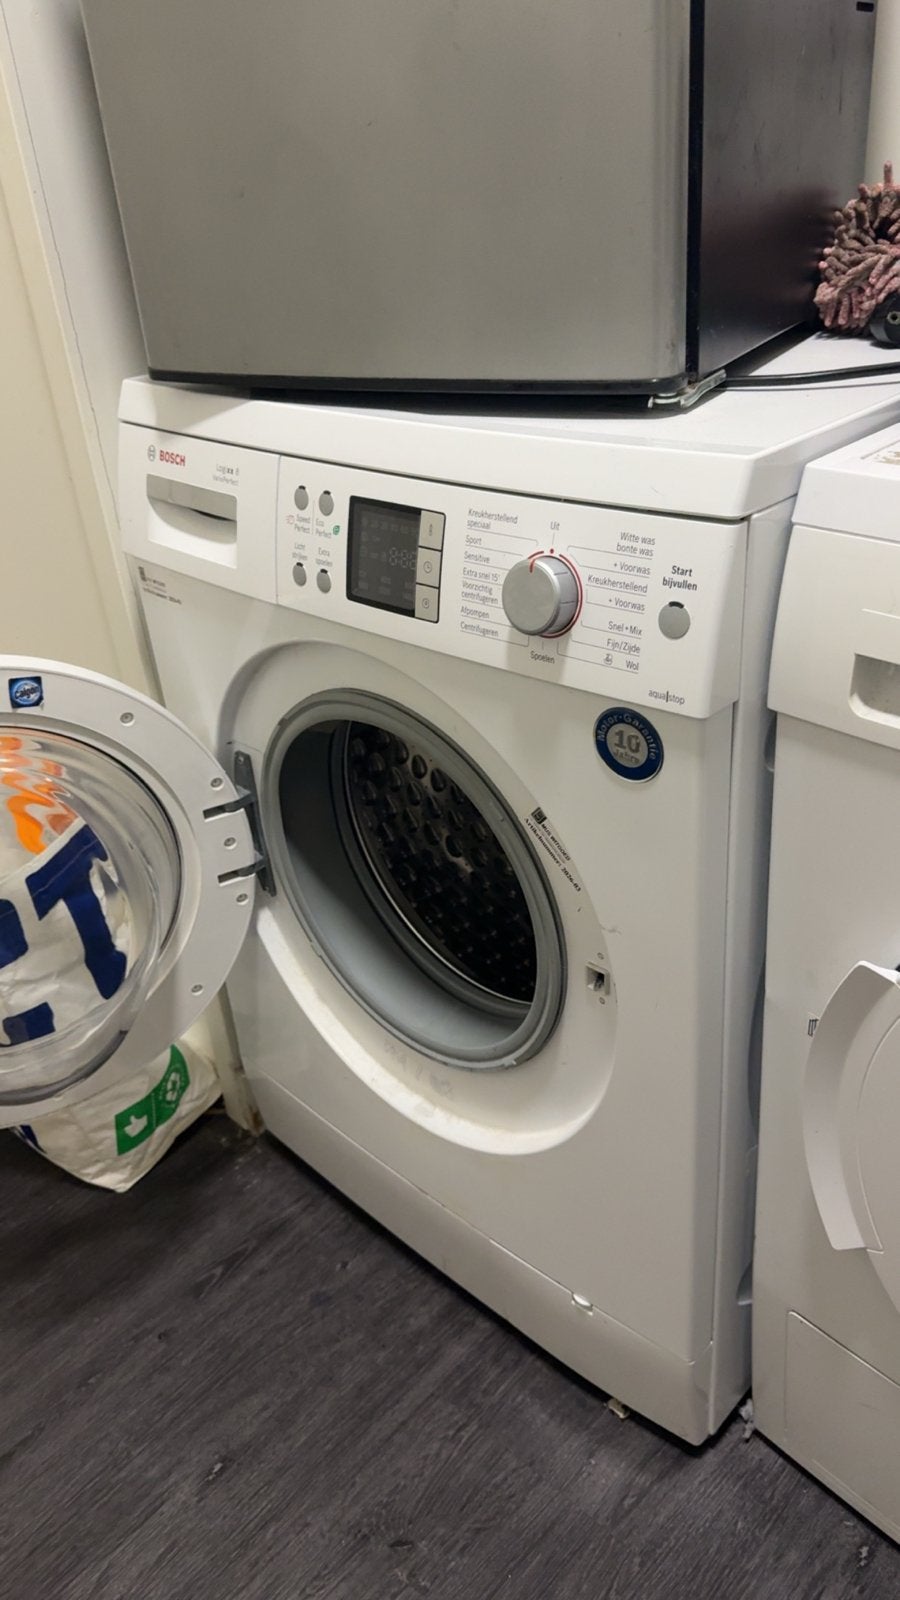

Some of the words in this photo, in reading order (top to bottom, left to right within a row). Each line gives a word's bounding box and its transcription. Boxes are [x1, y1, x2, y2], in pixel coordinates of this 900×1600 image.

[159, 449, 186, 467] BOSCH
[468, 508, 518, 524] Kreukherstellend
[467, 519, 491, 530] speciaal
[550, 521, 560, 531] Uit
[465, 534, 482, 545] Sport
[620, 532, 640, 543] Witte
[641, 536, 656, 546] was
[464, 550, 490, 563] Sensitive
[616, 543, 638, 554] bonte
[639, 548, 654, 557] was
[463, 567, 478, 578] Extra
[478, 571, 491, 580] snel
[619, 562, 651, 575] Voorwas
[671, 565, 692, 577] Start
[462, 580, 493, 596] Voorzichtig
[587, 574, 649, 593] Kreukherstellend
[662, 576, 698, 591] bijvullen
[461, 591, 499, 605] centrifugeren
[614, 597, 646, 612] Voorwas
[460, 606, 490, 619] Afpompen
[460, 621, 499, 637] Centrifugeren
[606, 638, 641, 654] Fijn/Zijde
[529, 650, 555, 665] Spoelen
[625, 660, 640, 671] Wol
[14, 685, 41, 700] Calgon
[614, 729, 641, 753] 10
